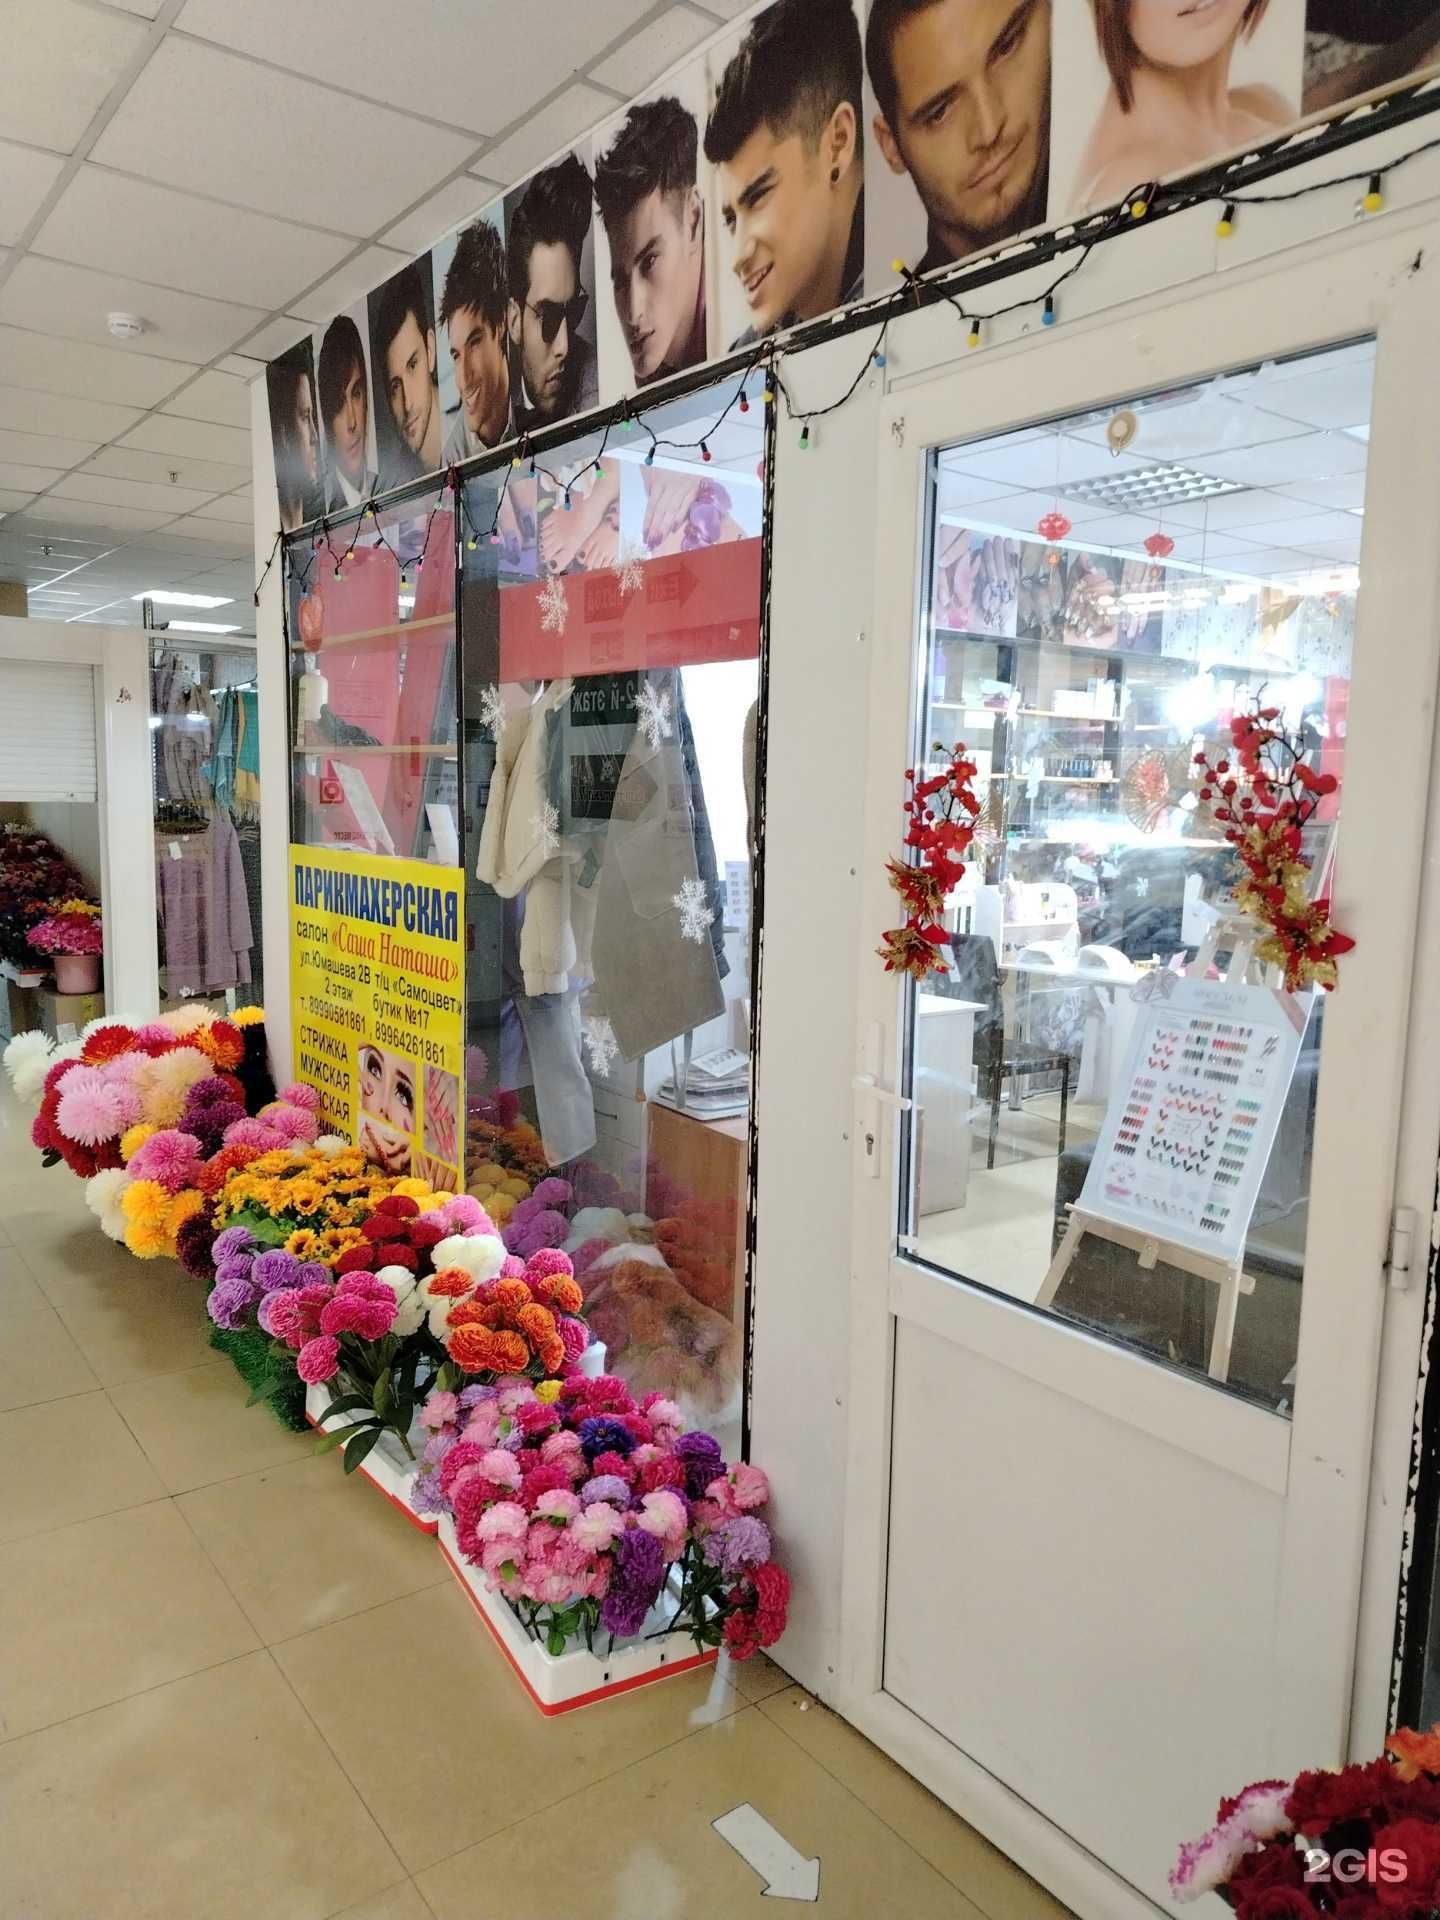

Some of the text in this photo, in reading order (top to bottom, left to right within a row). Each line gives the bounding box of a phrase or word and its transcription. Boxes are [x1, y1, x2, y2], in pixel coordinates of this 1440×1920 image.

[295, 864, 458, 942] ПАРИКМАХЕРСКАЯ
[296, 920, 459, 983] салон «Саша Наташа»
[325, 976, 430, 1030] 2 этаж бутик №17
[358, 963, 371, 985] 2В
[375, 971, 389, 995] т/ц
[393, 976, 462, 1016] «Самоцвет»
[300, 1024, 348, 1063] СТРИЖКА
[375, 1021, 445, 1067] 89964261861
[301, 1052, 350, 1095] МУЖСКАЯ
[301, 1080, 350, 1123] СКАЯ
